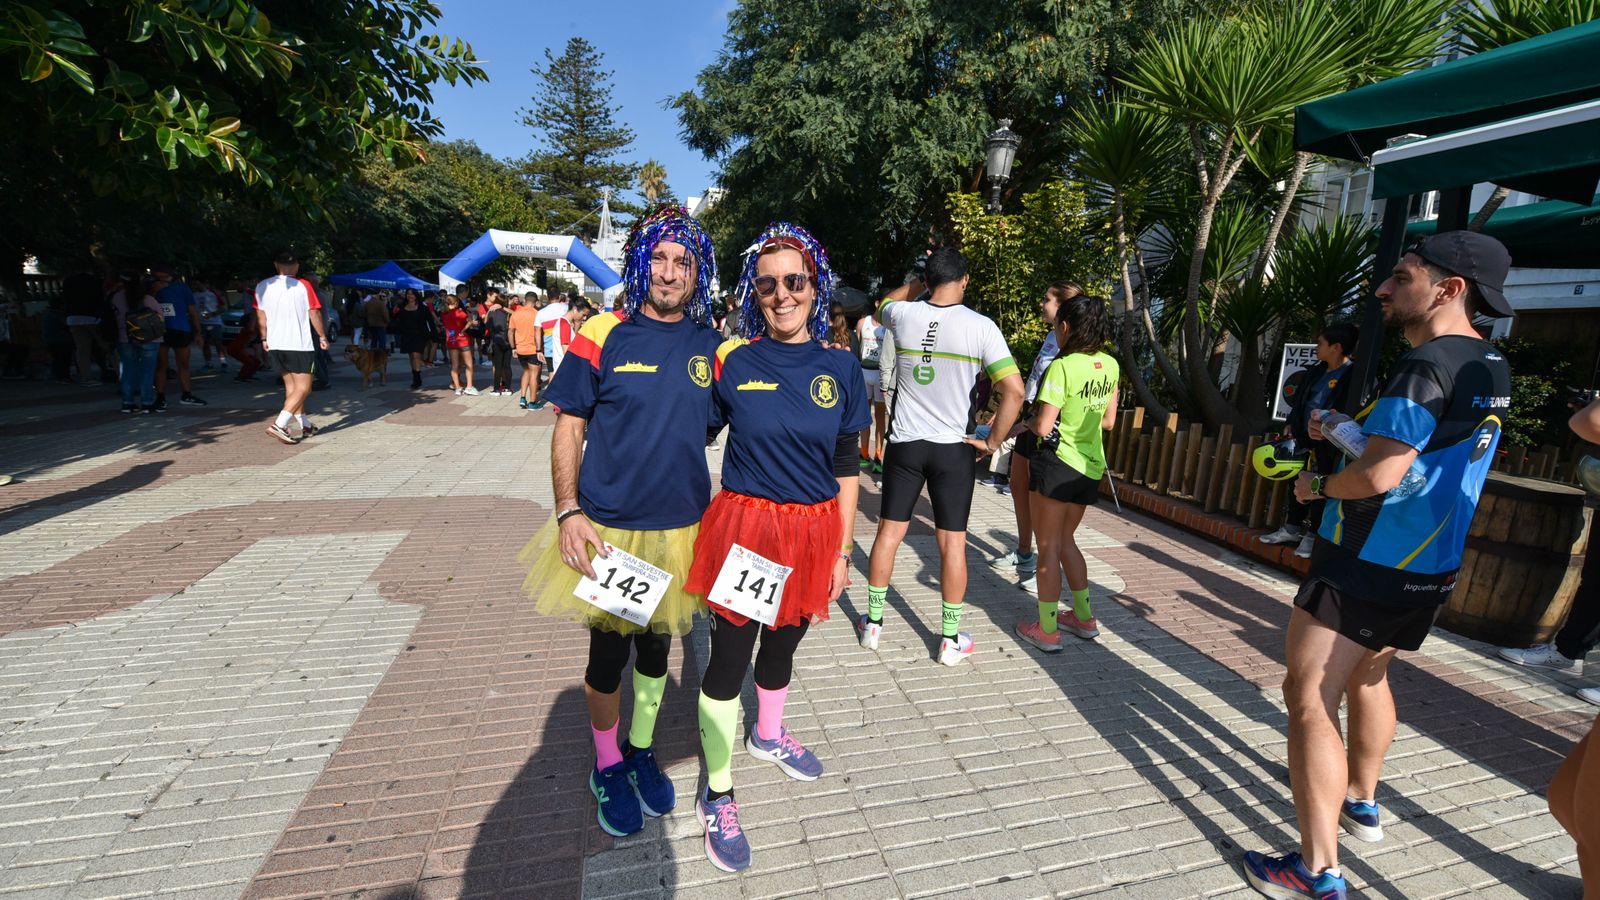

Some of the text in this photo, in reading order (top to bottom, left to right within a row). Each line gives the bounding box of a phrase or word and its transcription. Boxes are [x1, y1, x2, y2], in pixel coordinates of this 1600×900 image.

[918, 321, 939, 381] marlins
[622, 554, 637, 565] SAN
[637, 561, 670, 581] SILVESTRE
[752, 555, 764, 566] SAN
[599, 568, 650, 604] 142
[733, 569, 778, 605] 141
